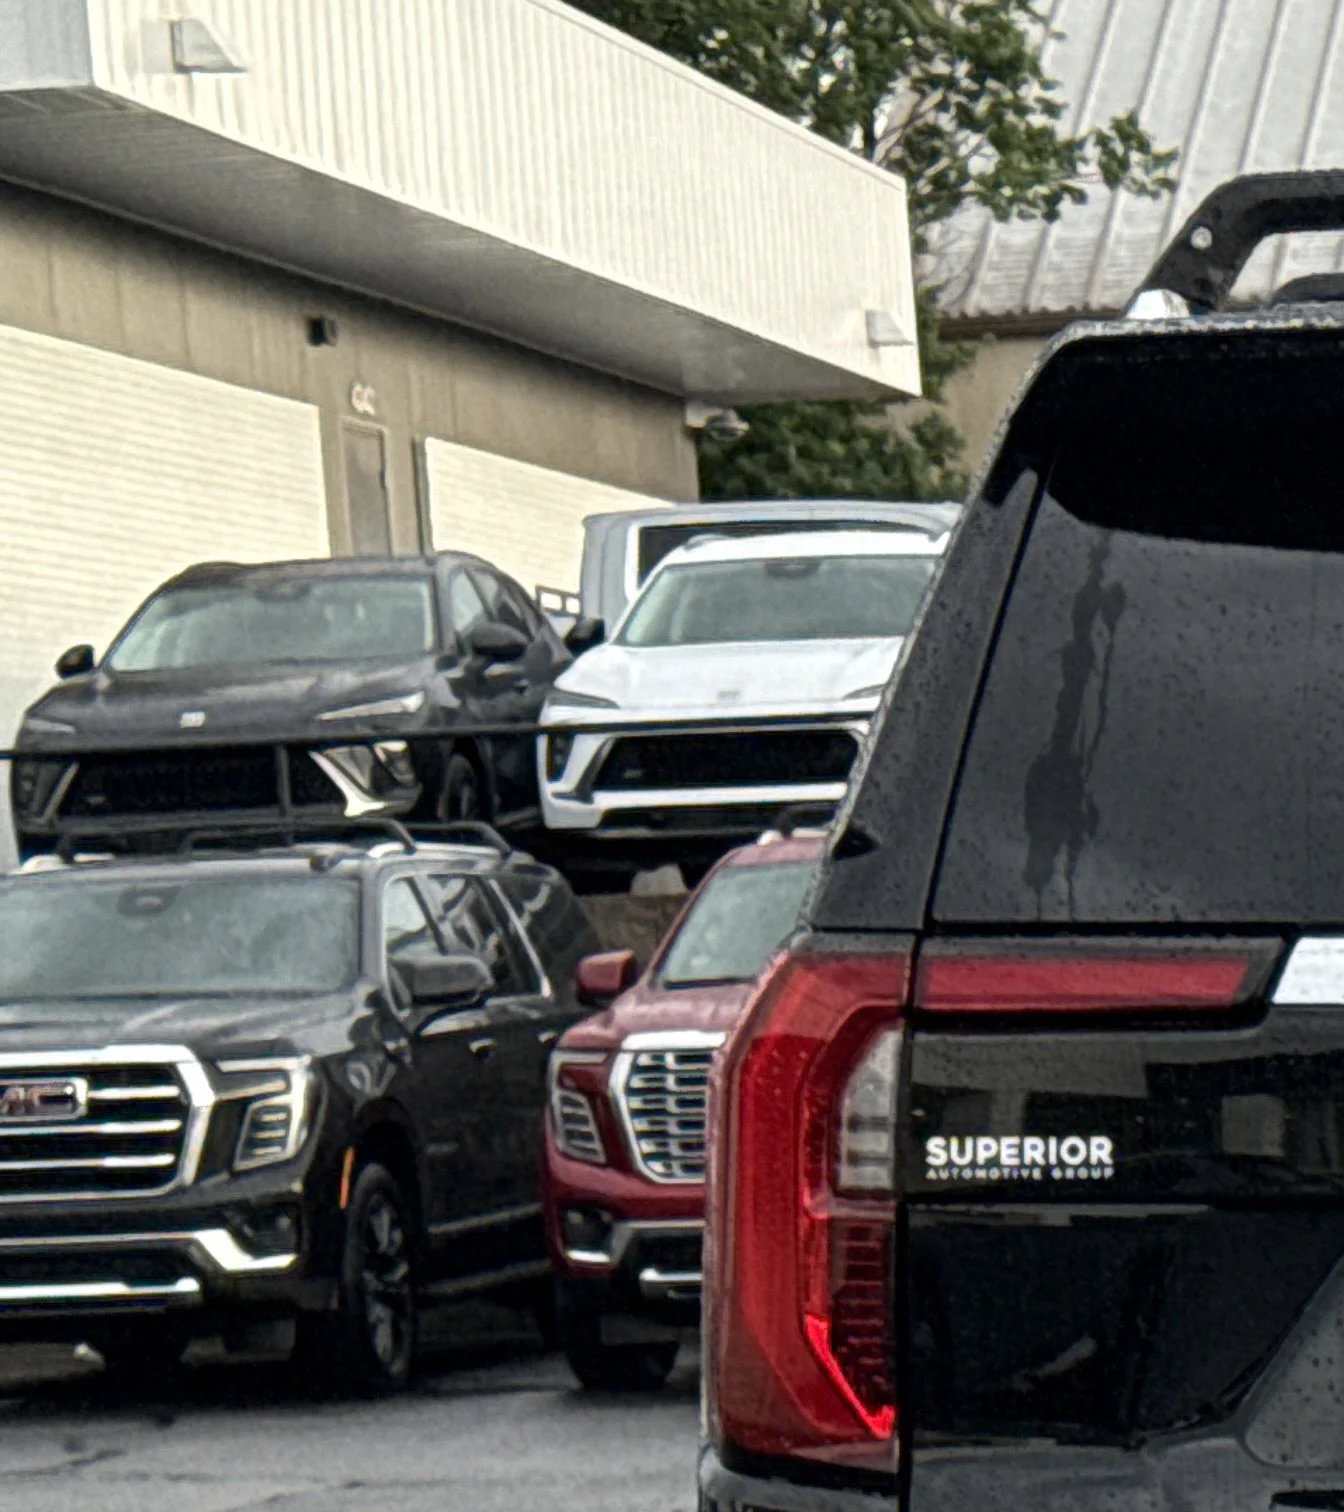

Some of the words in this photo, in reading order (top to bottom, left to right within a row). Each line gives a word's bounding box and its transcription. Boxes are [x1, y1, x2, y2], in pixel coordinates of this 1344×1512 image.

[925, 1136, 1113, 1166] SUPERIOR
[925, 1167, 1042, 1180] AUTOMOTIVE
[1051, 1167, 1114, 1180] GROUP
